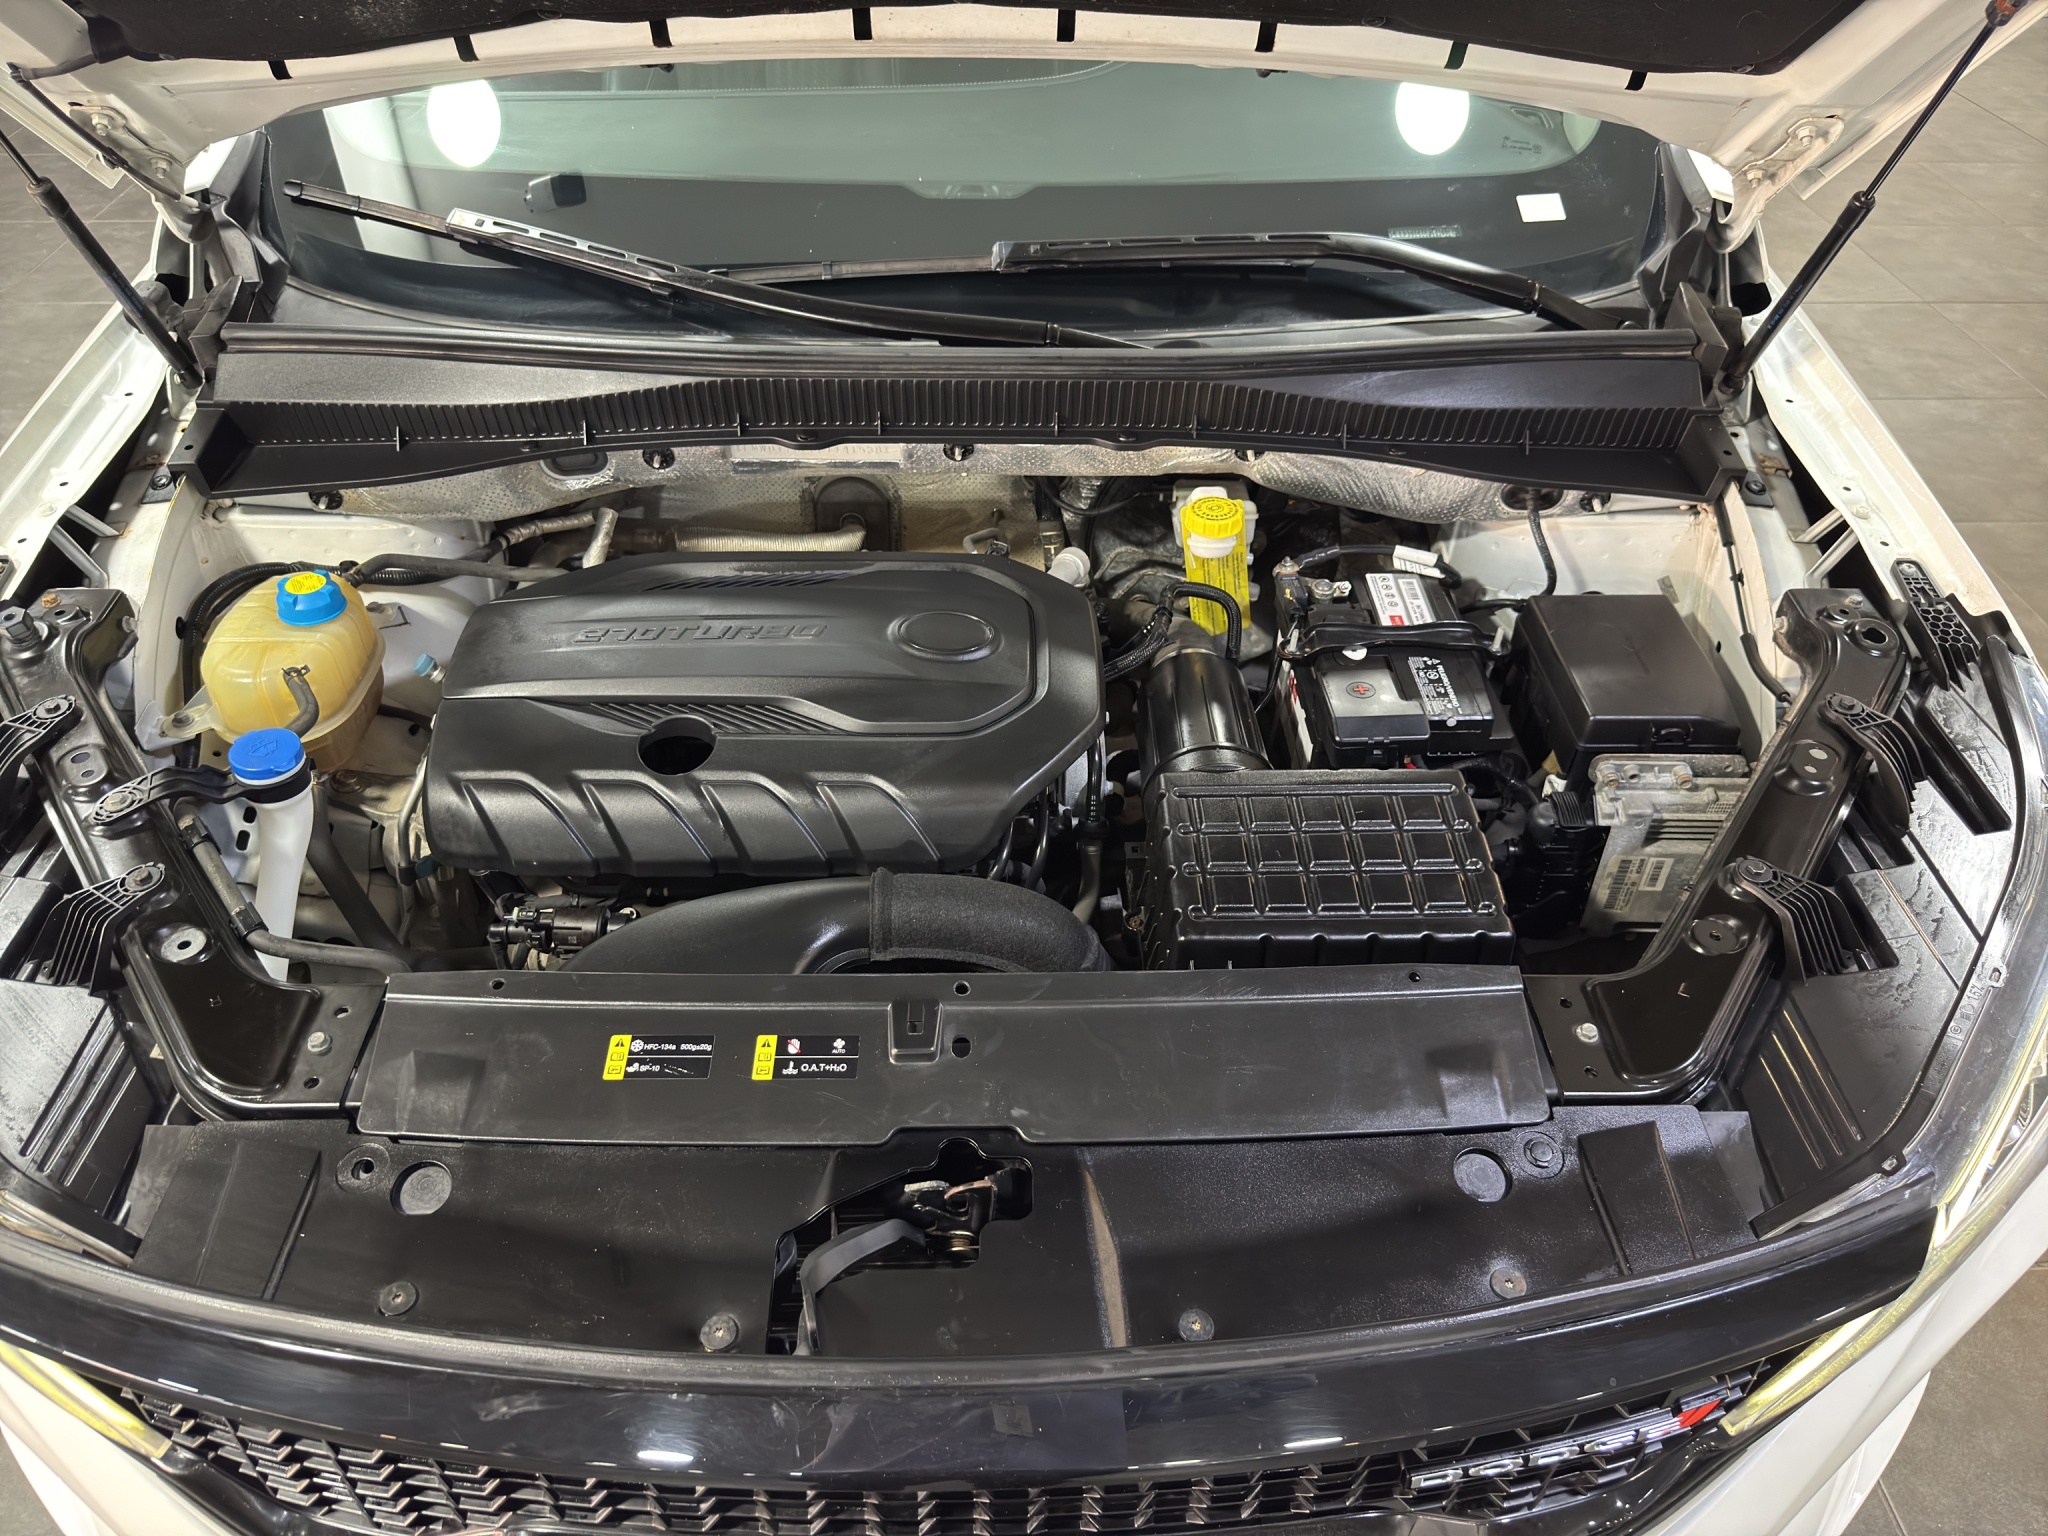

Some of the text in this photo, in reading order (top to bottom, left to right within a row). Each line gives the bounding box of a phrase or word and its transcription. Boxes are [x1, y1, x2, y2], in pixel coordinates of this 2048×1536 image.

[573, 624, 828, 643] 270TURBO
[643, 1043, 677, 1051] HFC-134a
[640, 1064, 660, 1072] SP-10
